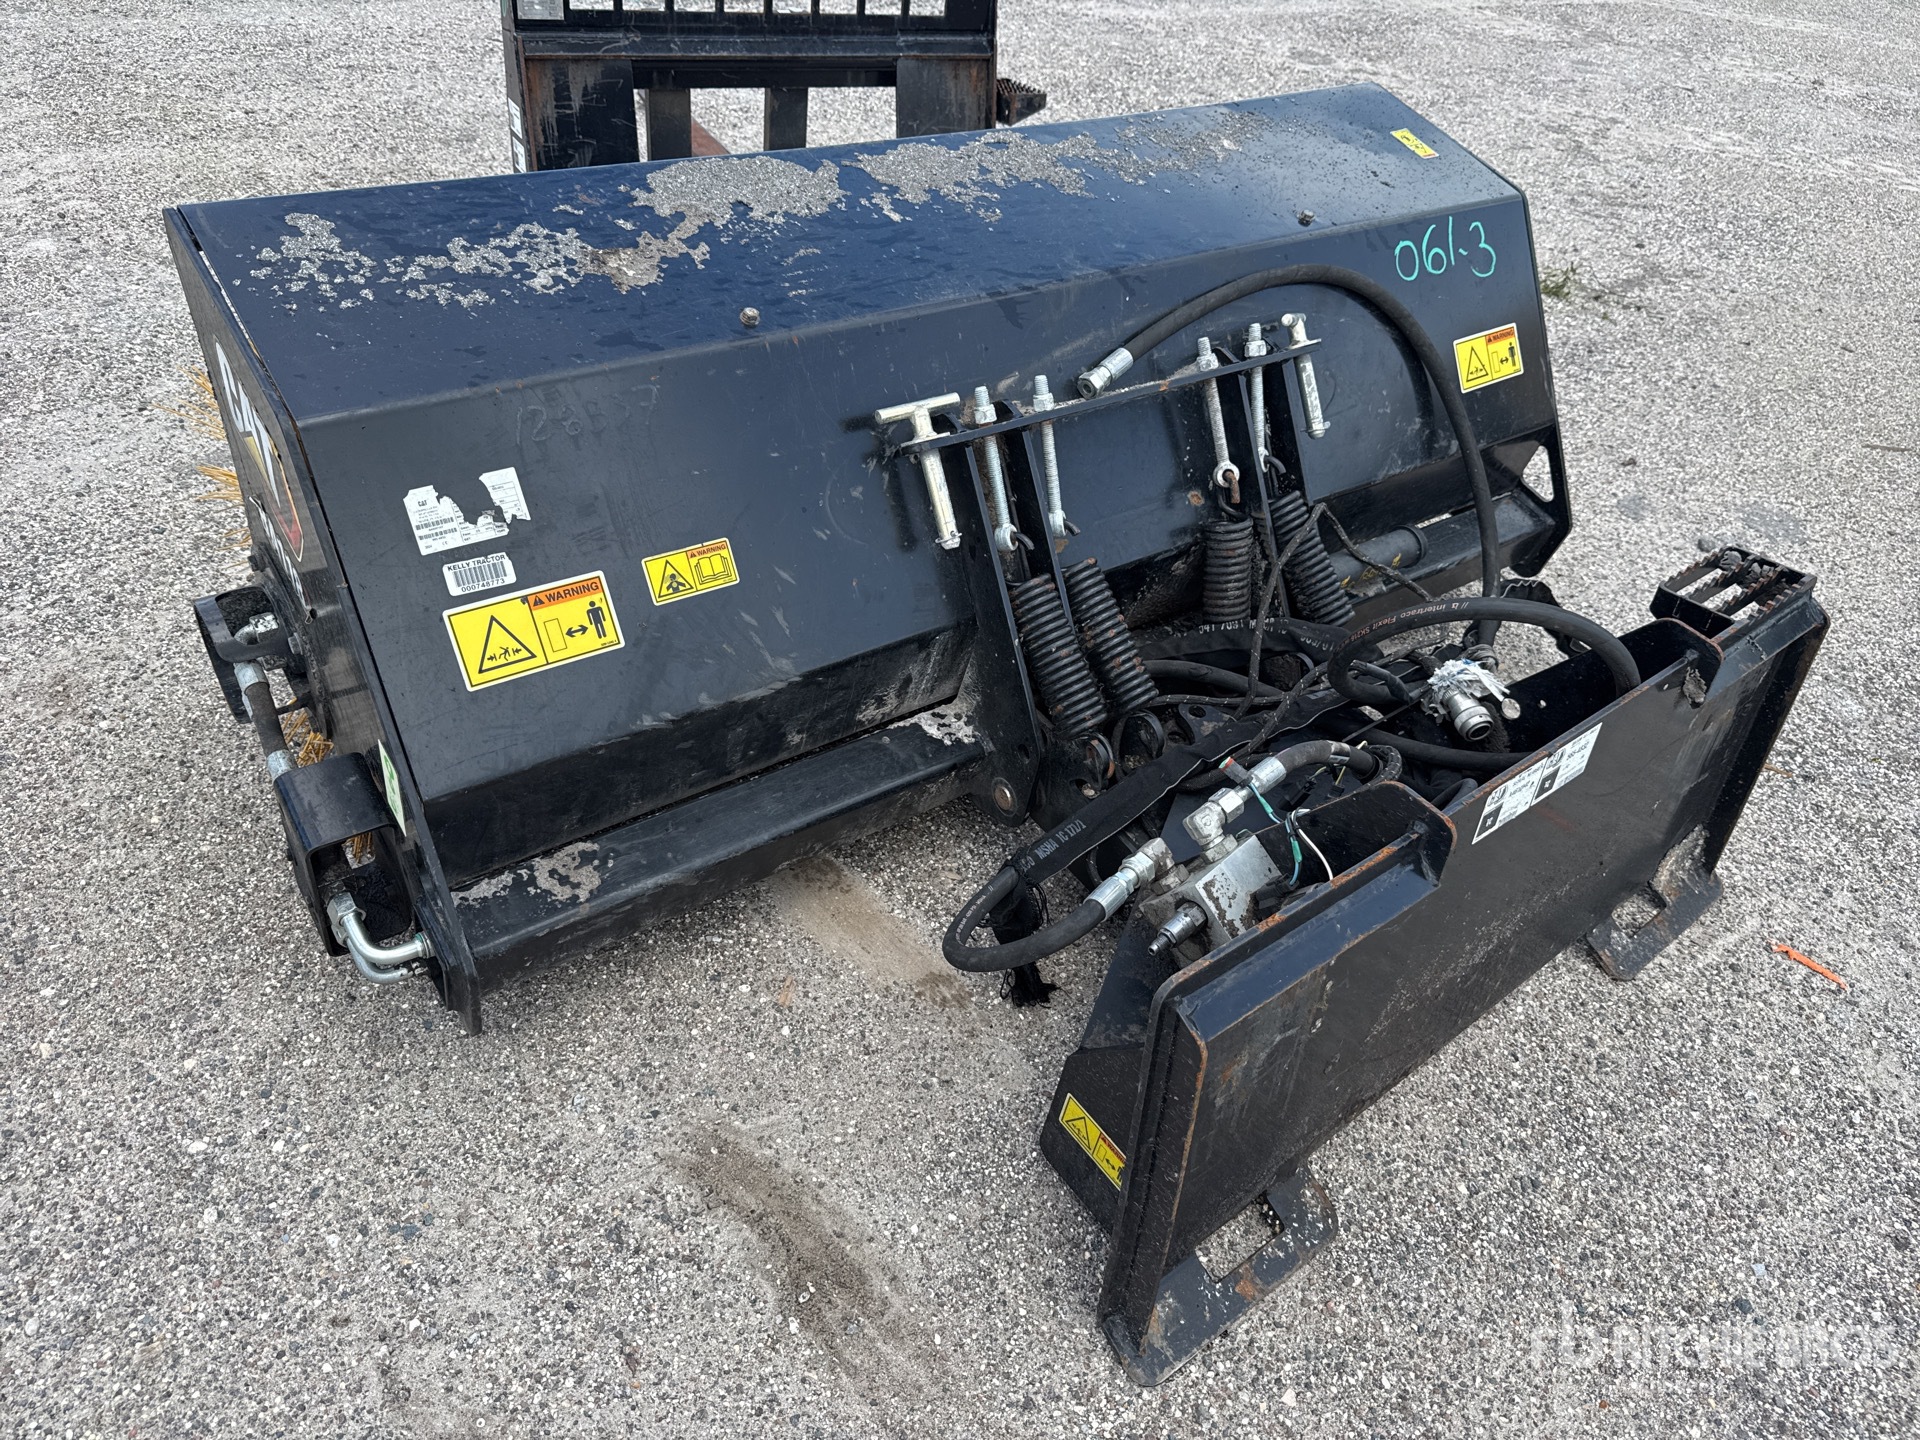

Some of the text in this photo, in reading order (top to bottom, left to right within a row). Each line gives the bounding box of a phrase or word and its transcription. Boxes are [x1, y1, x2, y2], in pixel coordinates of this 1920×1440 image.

[1492, 329, 1515, 341] WARNING
[697, 544, 726, 556] WARNING
[447, 554, 506, 571] KELLY TRACTOR
[461, 578, 505, 593] 000748773
[545, 581, 599, 603] WARNING
[1400, 603, 1446, 619] intertraco
[1372, 615, 1397, 631] Flexit
[1034, 838, 1059, 860] MSHA
